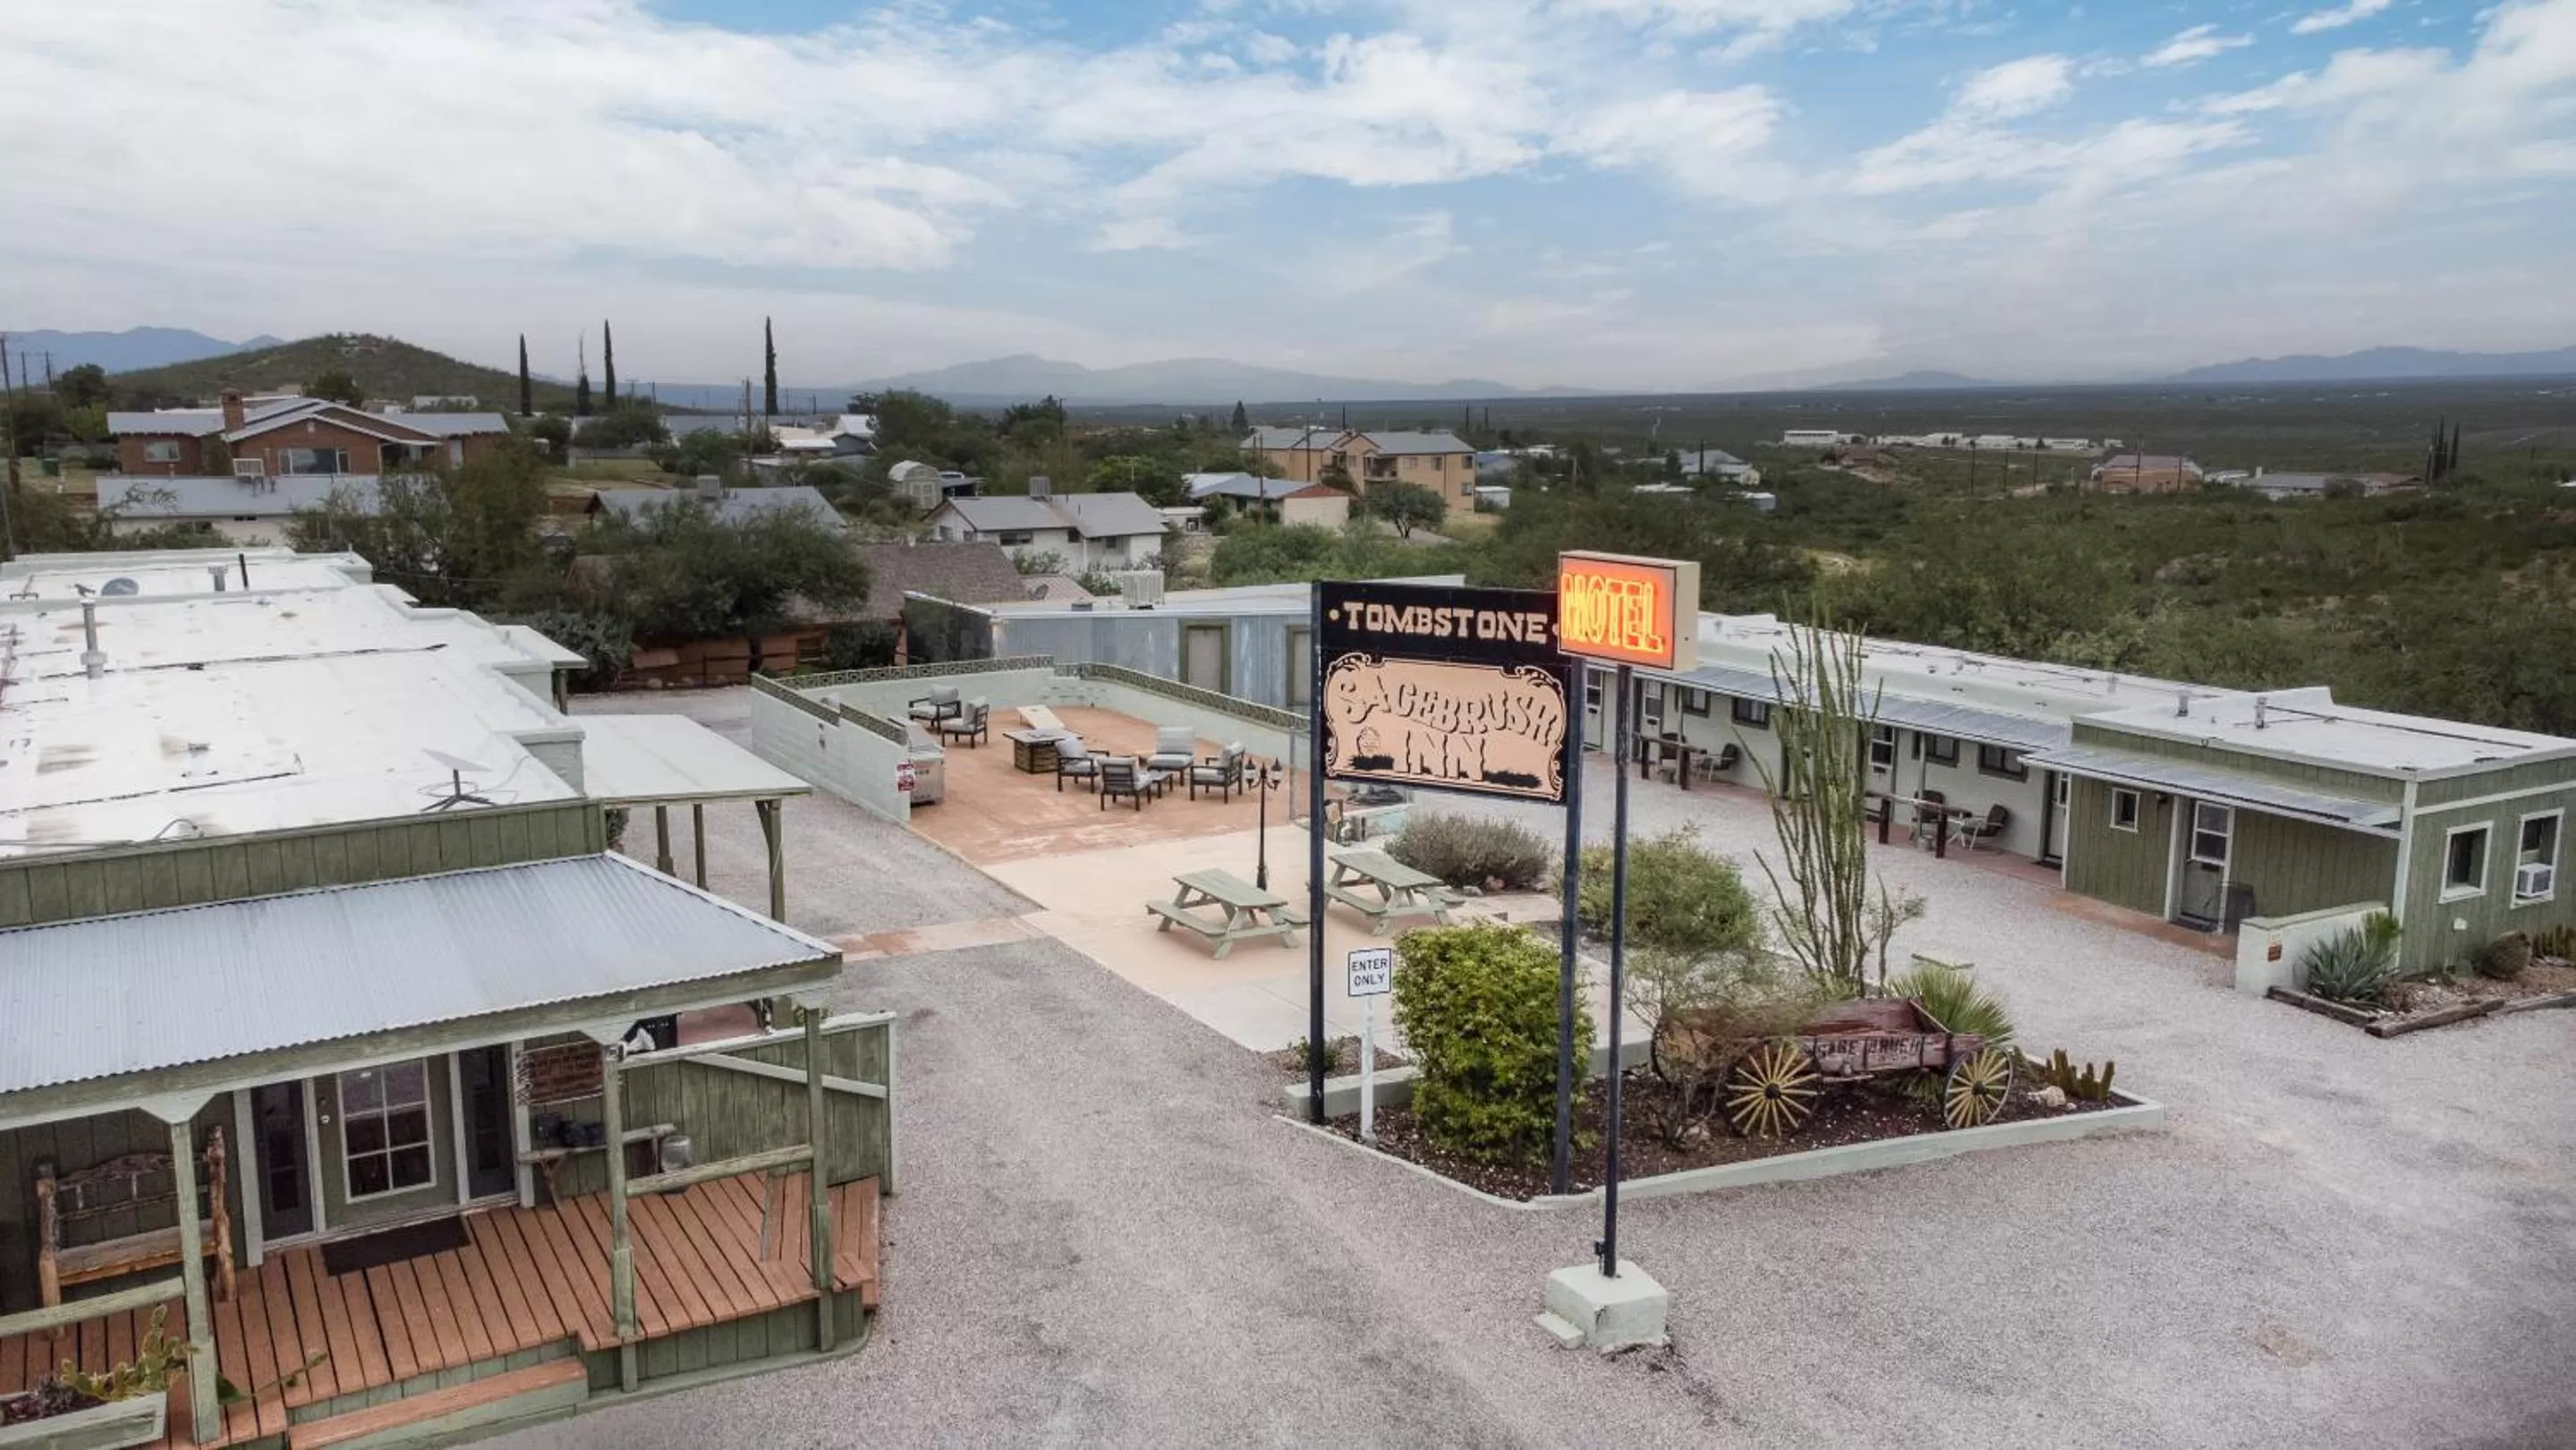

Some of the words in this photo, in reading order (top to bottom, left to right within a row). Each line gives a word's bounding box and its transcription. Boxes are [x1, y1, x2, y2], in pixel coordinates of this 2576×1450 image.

[1342, 601, 1549, 644] TOMBSTONE
[1560, 573, 1664, 653] MOTEL
[1337, 673, 1558, 747] SAGEBRUSH
[1392, 729, 1486, 781] INN
[1351, 958, 1388, 971] ENTER
[1354, 973, 1385, 986] ONLY
